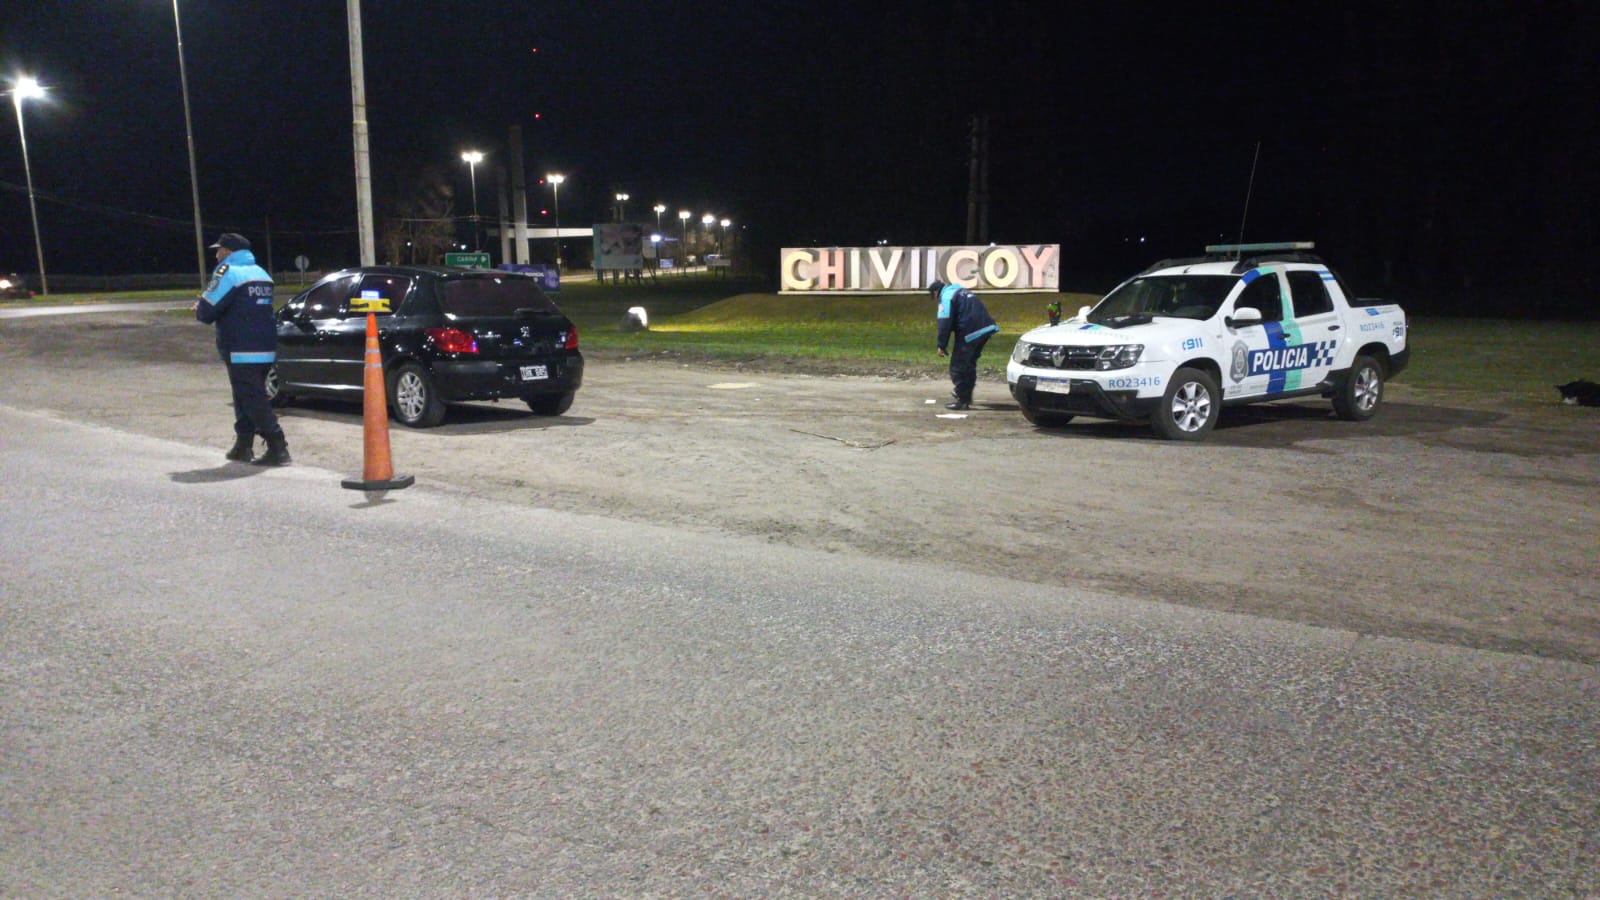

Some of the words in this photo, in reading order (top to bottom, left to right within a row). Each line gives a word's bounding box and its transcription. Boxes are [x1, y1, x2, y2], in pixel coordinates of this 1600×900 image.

[1187, 337, 1203, 350] 911
[1253, 347, 1308, 372] POLICIA
[1108, 376, 1161, 388] RO23416
